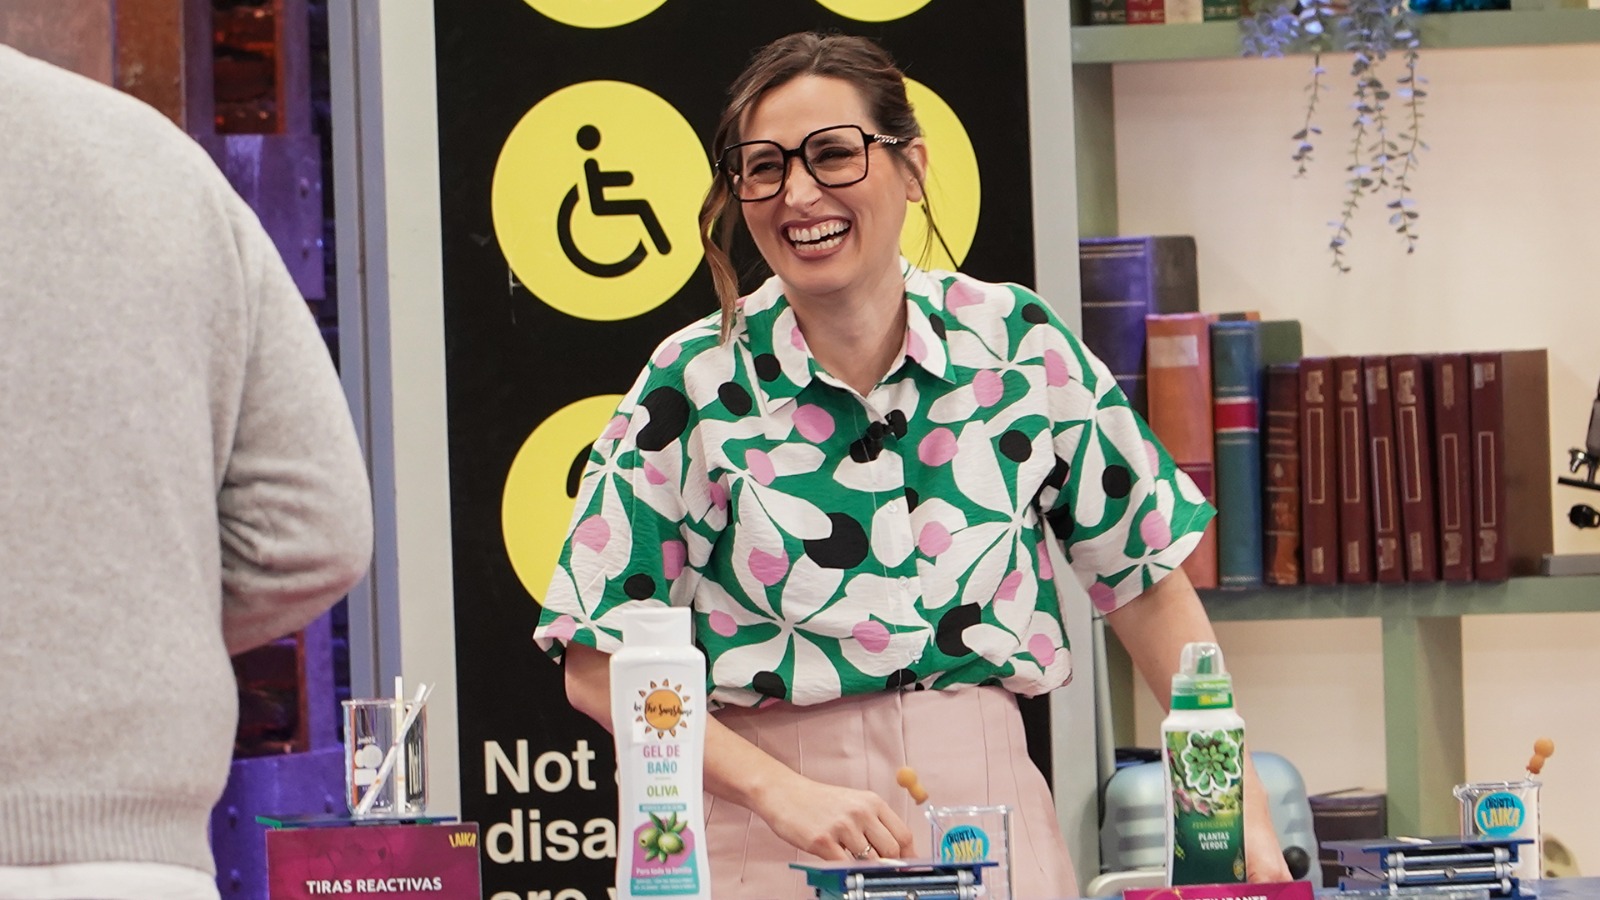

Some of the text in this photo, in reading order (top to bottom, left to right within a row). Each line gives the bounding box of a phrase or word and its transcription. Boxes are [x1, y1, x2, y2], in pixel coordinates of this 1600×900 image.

[643, 745, 681, 758] GEL DE
[484, 738, 597, 795] Not
[647, 759, 678, 774] BAÑO
[646, 784, 679, 797] OLIVA
[1481, 807, 1520, 828] LAIKA
[1198, 832, 1230, 841] PLANTAS
[1200, 840, 1229, 850] VERDES
[306, 877, 442, 894] TIRAS REACTIVAS
